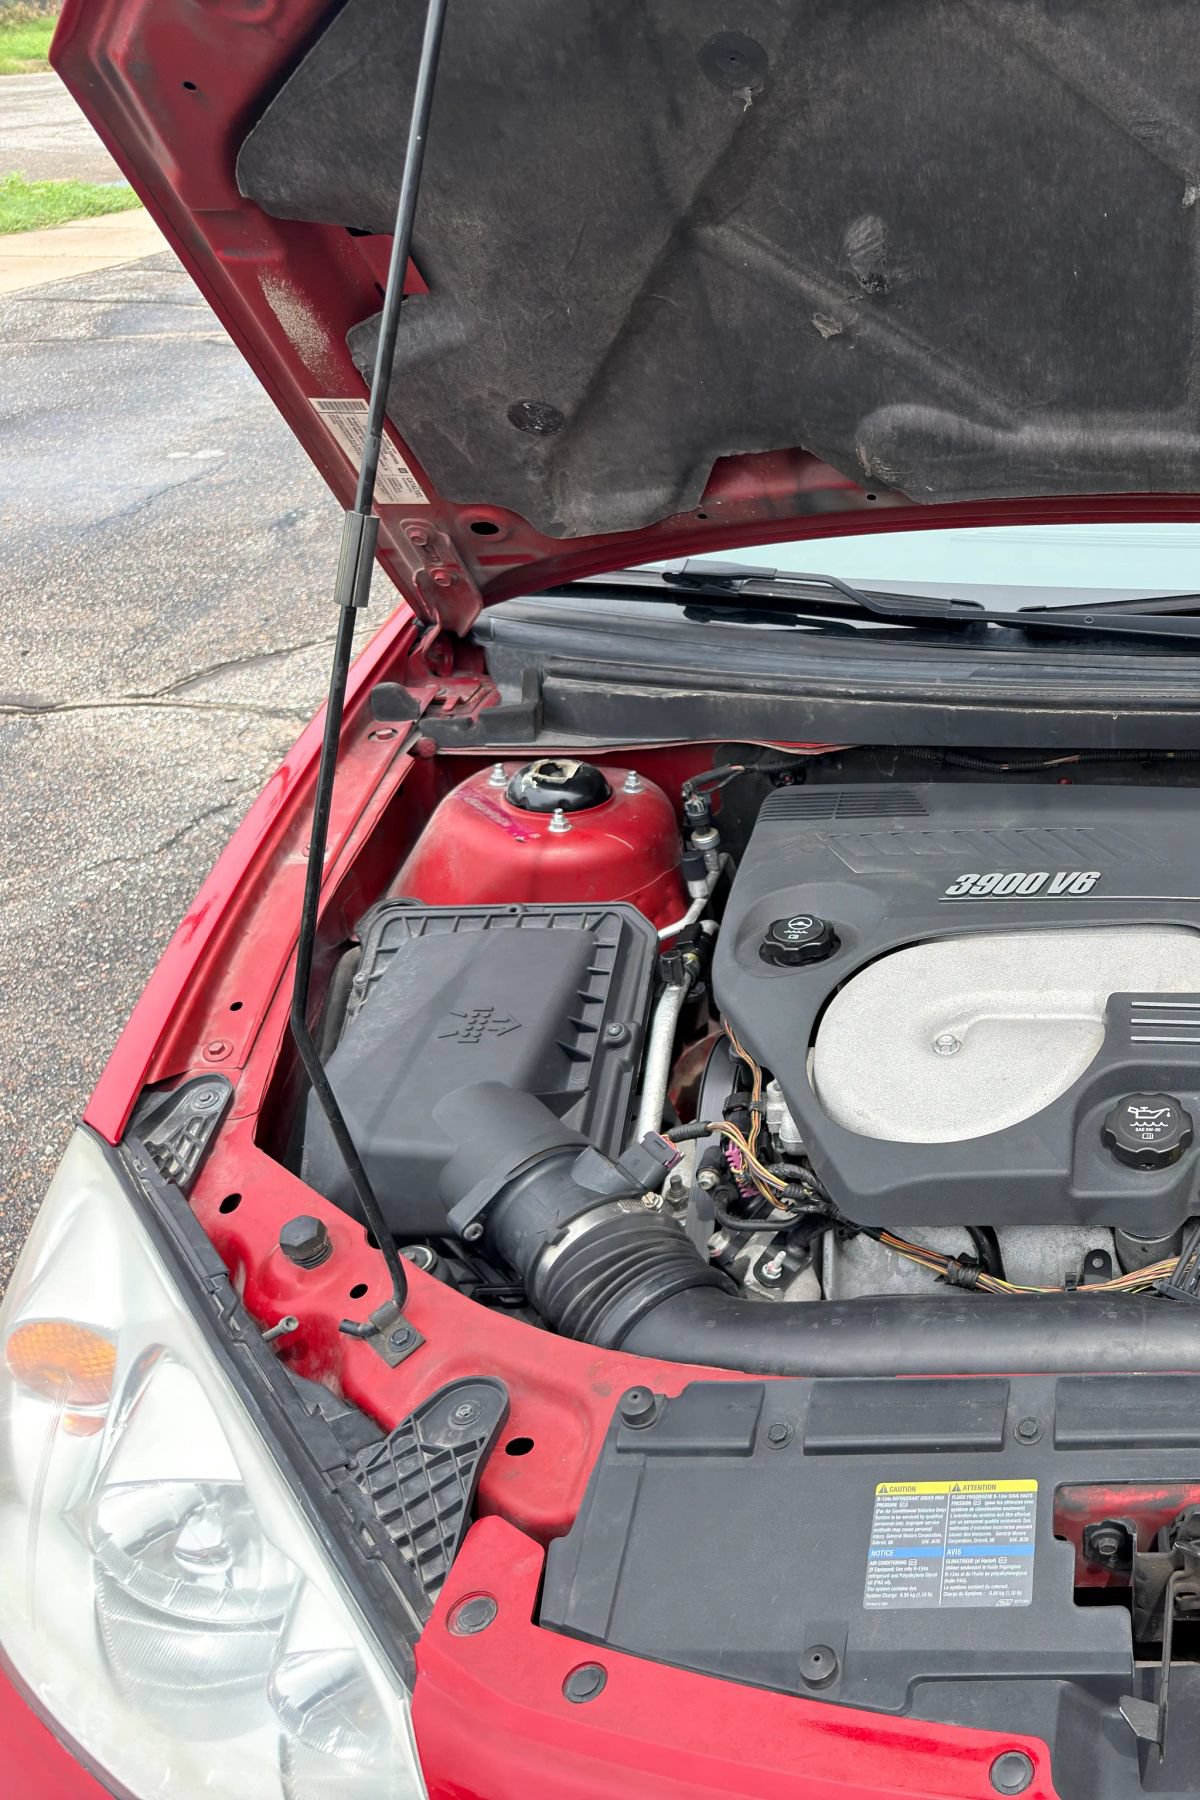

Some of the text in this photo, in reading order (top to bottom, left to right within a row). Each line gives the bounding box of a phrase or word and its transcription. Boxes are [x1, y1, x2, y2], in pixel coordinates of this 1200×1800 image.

[945, 872, 1101, 896] 3900 V6
[889, 1485, 916, 1493] CAUTION
[871, 1549, 895, 1557] NOTICE
[946, 1548, 962, 1556] AVIS
